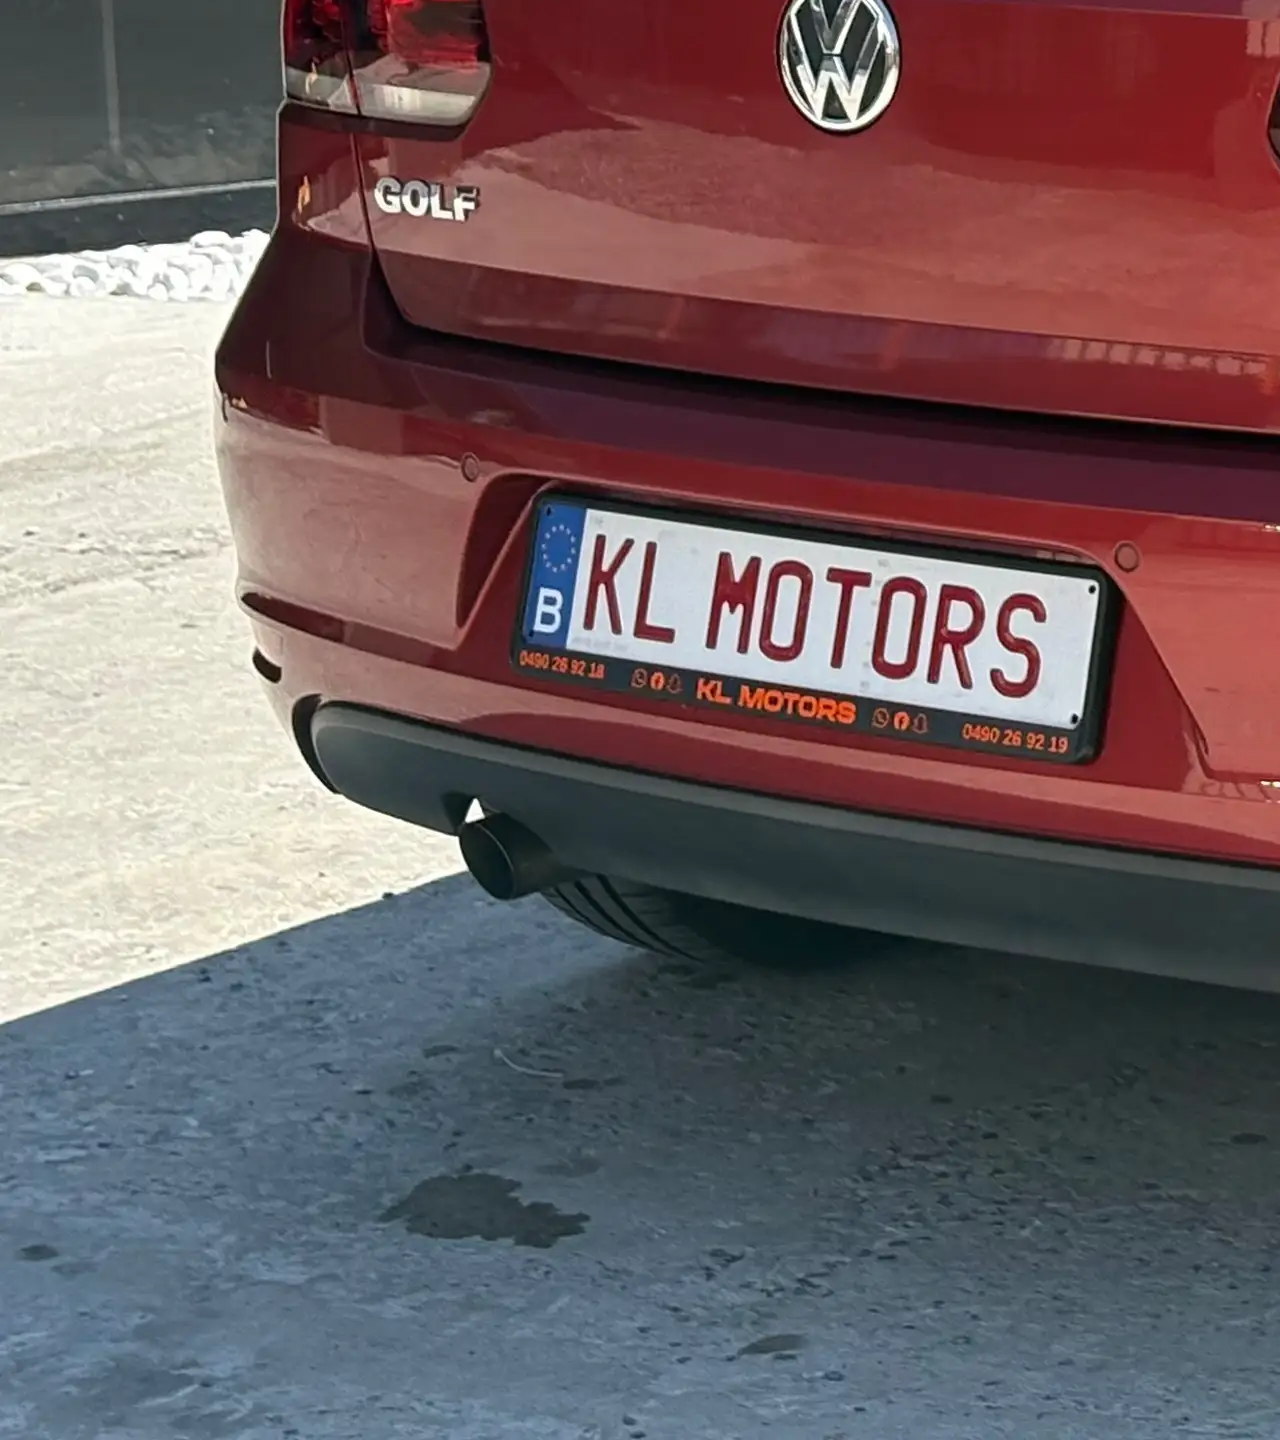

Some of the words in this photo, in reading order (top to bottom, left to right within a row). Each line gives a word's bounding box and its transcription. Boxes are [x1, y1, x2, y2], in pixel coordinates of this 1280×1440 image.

[374, 176, 480, 222] GOLF
[533, 587, 563, 633] B
[582, 533, 676, 644] KL
[705, 551, 1048, 699] MOTORS
[696, 677, 733, 705] KL
[736, 684, 857, 725] MOTORS
[962, 722, 1001, 744] 0490
[1002, 728, 1022, 747] 26
[1025, 731, 1045, 751] 92
[1047, 735, 1069, 755] 19
